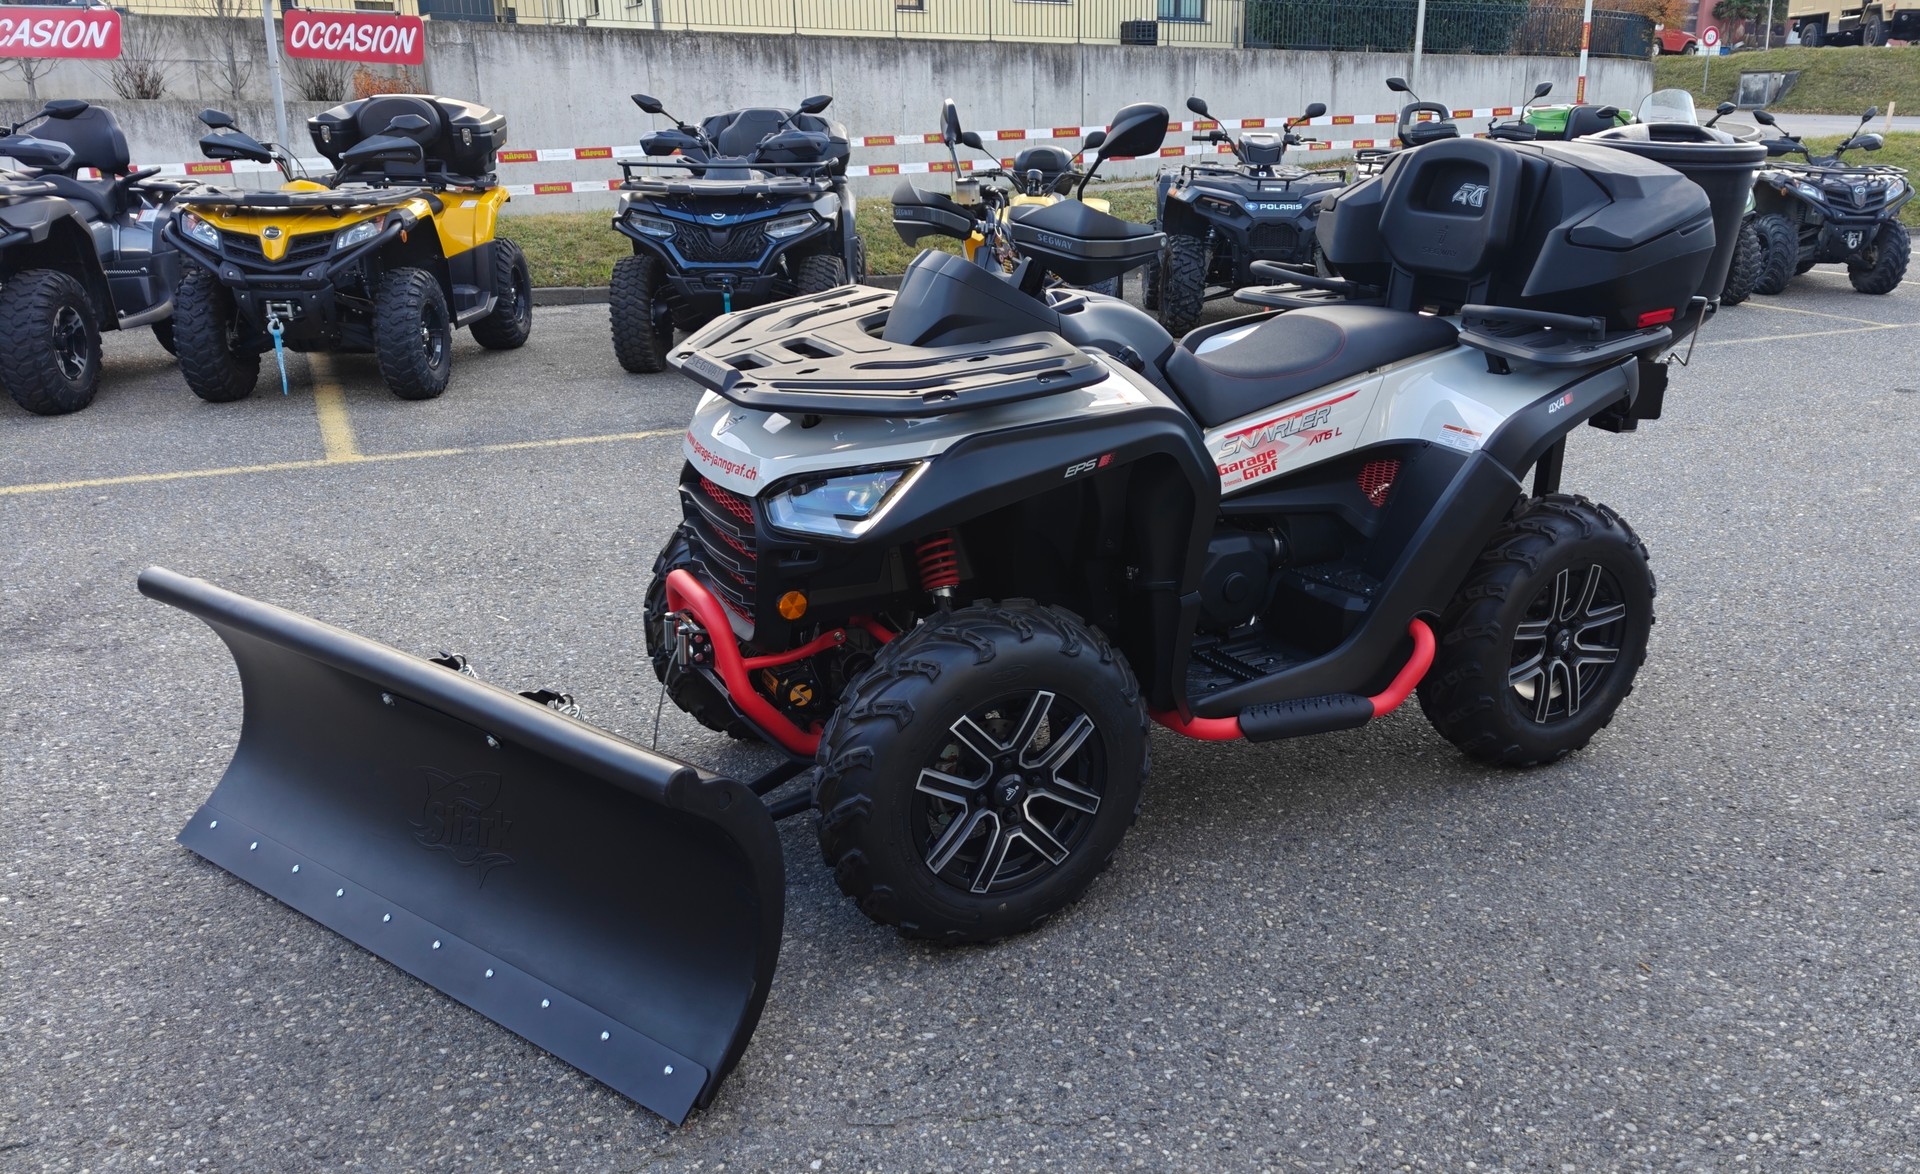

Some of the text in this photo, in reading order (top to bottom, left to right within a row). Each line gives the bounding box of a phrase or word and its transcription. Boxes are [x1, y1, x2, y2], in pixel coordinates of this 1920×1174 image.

[290, 20, 417, 55] OCCASION
[503, 153, 533, 161] KÄPPELI
[580, 149, 608, 157] KÄPPELI
[191, 163, 227, 173] KÄPPELI
[539, 184, 568, 193] KÄPPELI
[895, 208, 914, 217] SEGWAY
[1037, 233, 1073, 250] SEGWAY
[689, 356, 722, 378] SEGWAY
[1219, 405, 1332, 459] SNARLER
[1309, 427, 1343, 446] AT6 L
[687, 430, 757, 480] www.garage-janngraf.ch
[1217, 449, 1277, 476] Garage
[1064, 458, 1098, 478] EPS
[1242, 458, 1278, 480] Graf
[424, 801, 514, 849] Shark
